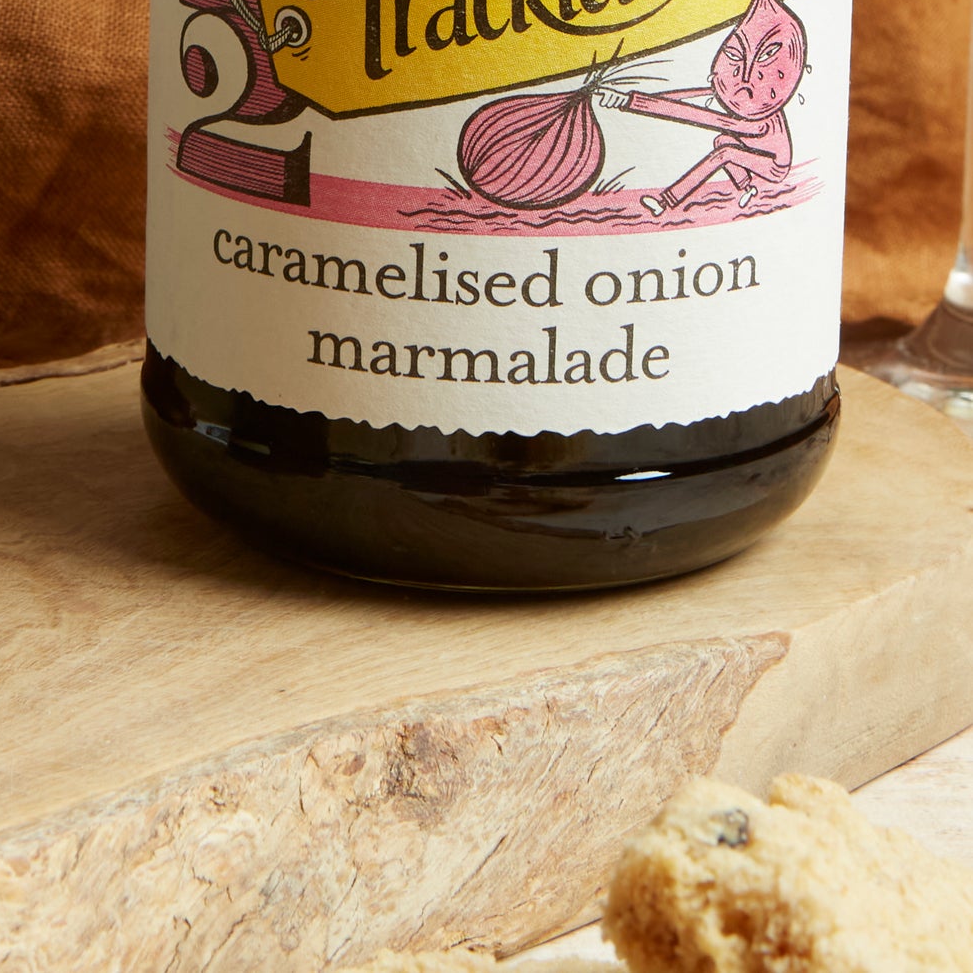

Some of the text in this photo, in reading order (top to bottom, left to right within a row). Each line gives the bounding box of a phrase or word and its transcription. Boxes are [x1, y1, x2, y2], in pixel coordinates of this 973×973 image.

[213, 228, 761, 308] caramelised onion
[307, 324, 670, 385] marmalade
